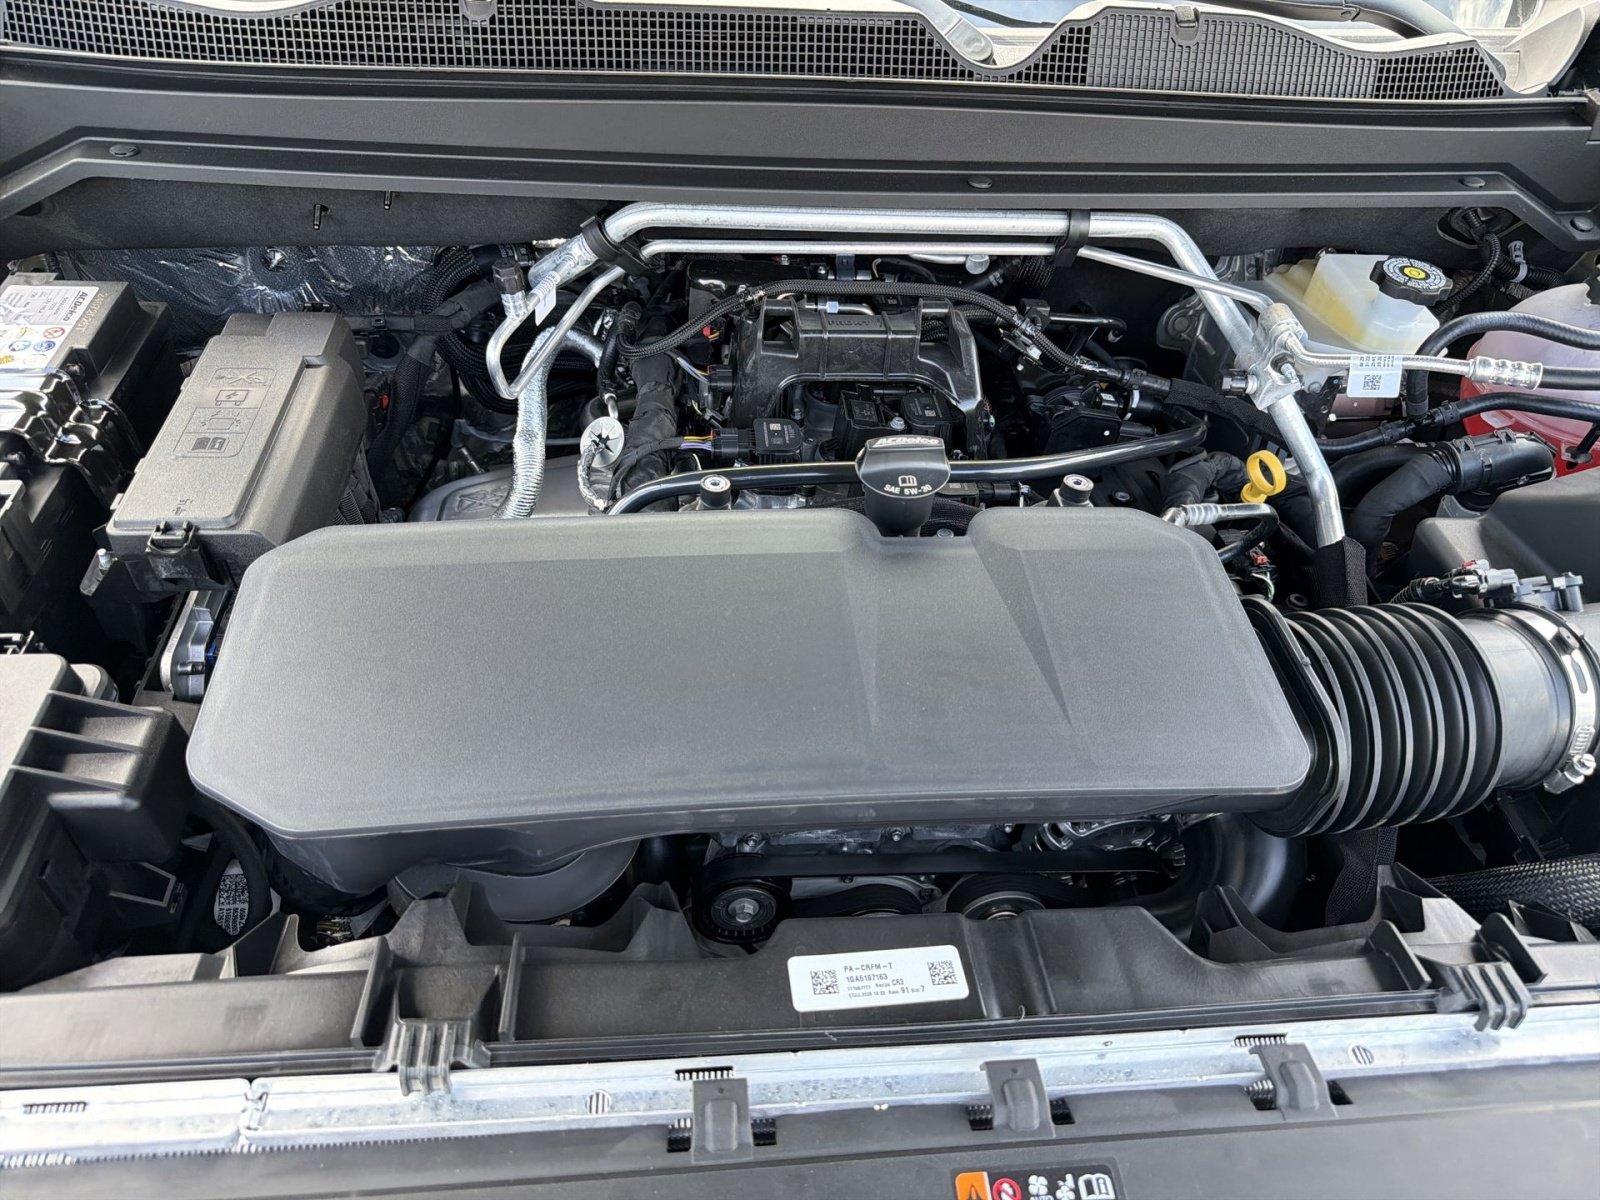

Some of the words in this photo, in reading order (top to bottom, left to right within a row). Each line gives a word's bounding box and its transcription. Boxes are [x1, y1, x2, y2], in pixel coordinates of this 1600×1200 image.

[63, 291, 88, 321] ACDelco
[872, 437, 939, 447] ACDelco
[883, 484, 901, 495] SAE
[904, 484, 932, 495] 5W-30
